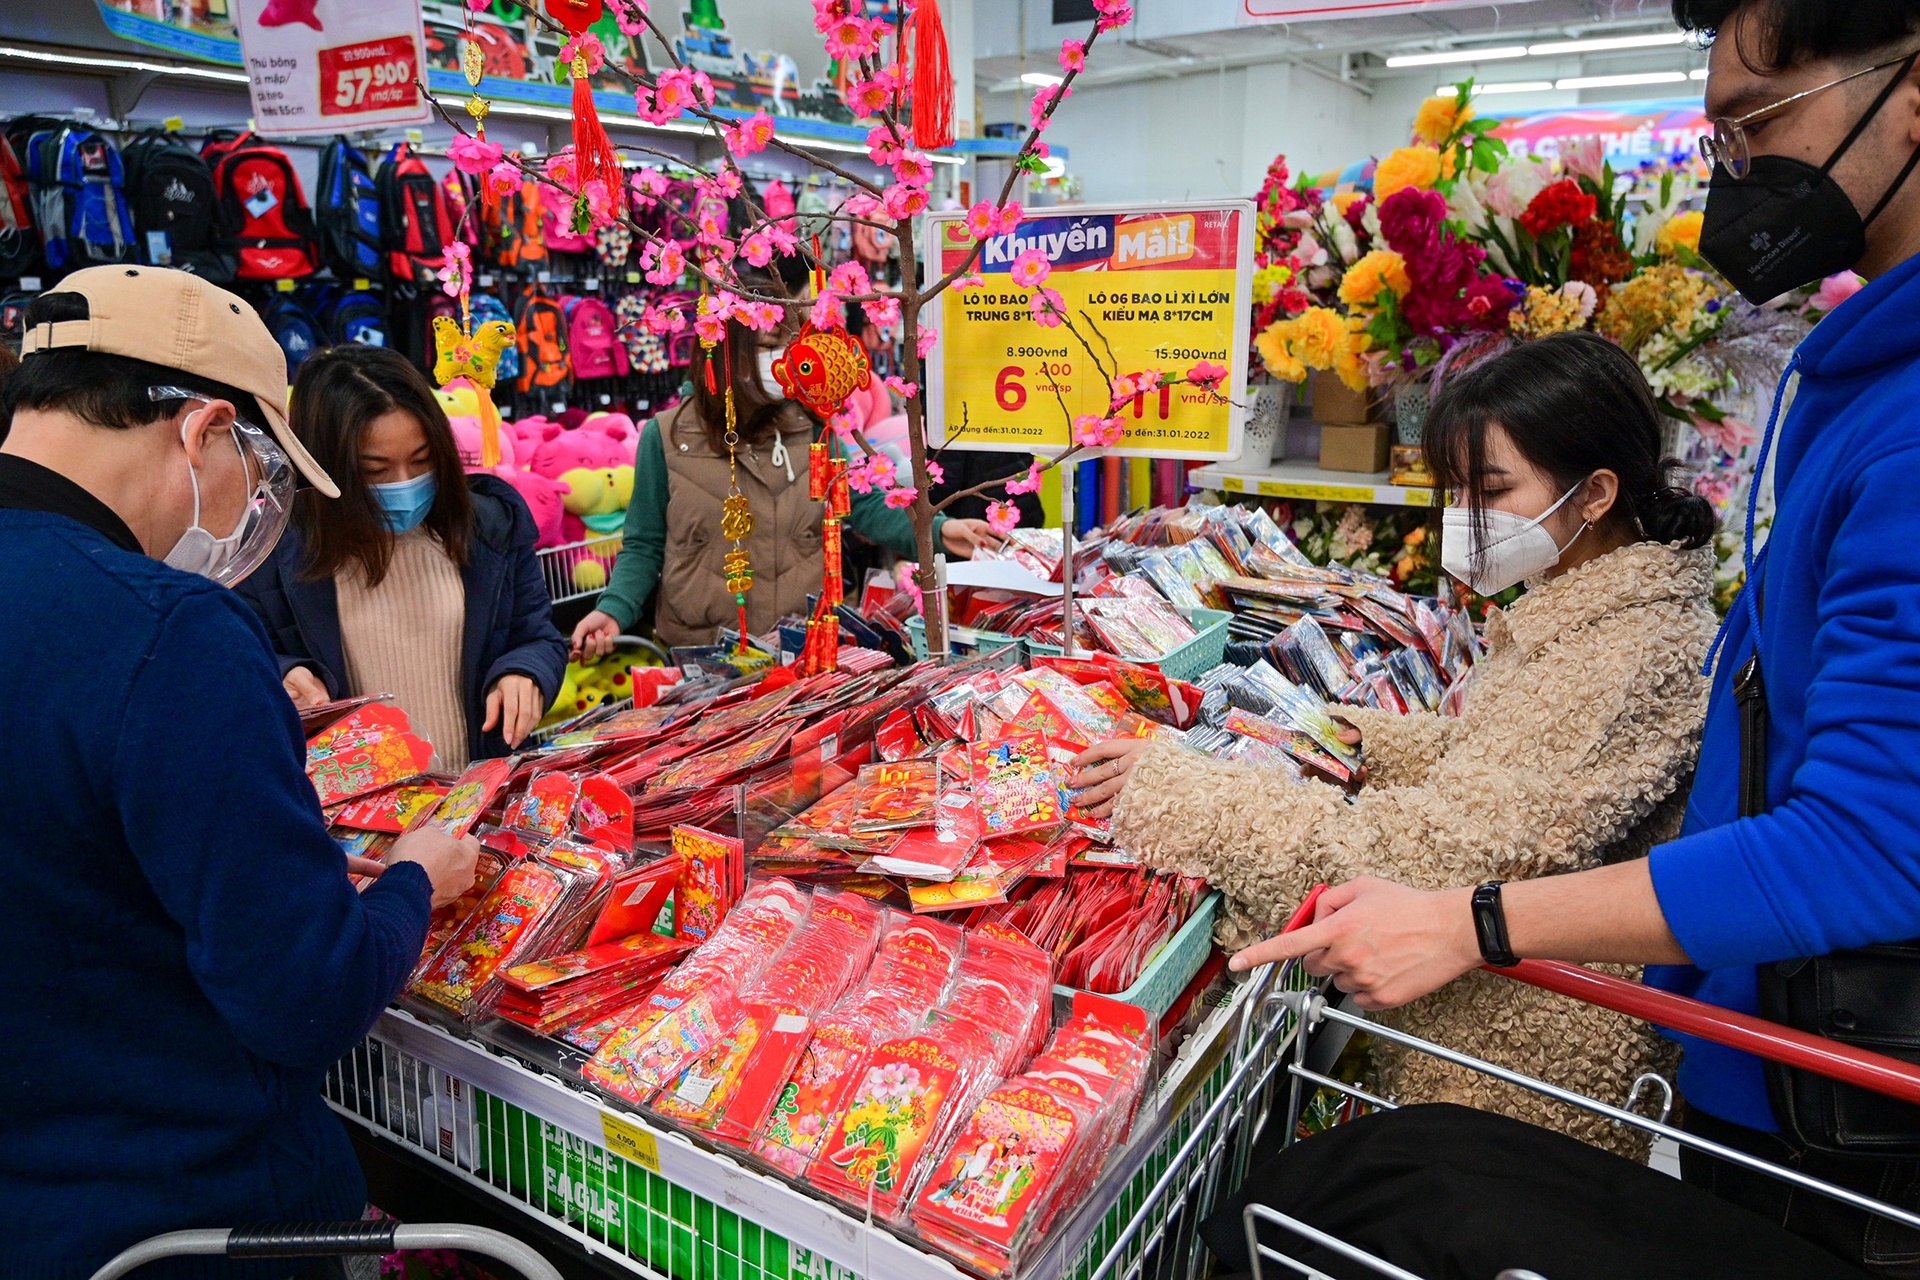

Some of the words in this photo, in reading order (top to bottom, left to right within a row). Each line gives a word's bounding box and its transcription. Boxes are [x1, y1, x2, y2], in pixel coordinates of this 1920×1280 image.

[984, 218, 1107, 264] Khuyến
[1118, 220, 1191, 263] Mãi!
[964, 292, 980, 305] LÔ
[983, 294, 997, 305] 10
[1000, 294, 1028, 305] BAO
[1088, 290, 1107, 304] LÔ
[1110, 293, 1128, 304] 06
[1131, 293, 1162, 304] BAO
[1165, 290, 1178, 304] LÌ
[1181, 290, 1195, 304] XÌ
[1199, 289, 1230, 304] LỚN
[966, 311, 1010, 321] TRUNG
[1103, 305, 1135, 321] KIỂU
[1138, 310, 1160, 324] MẠ
[995, 365, 1027, 412] 6
[540, 1121, 618, 1173] EAGLE
[617, 1133, 636, 1148] 4.000
[542, 1163, 620, 1228] EAGLE
